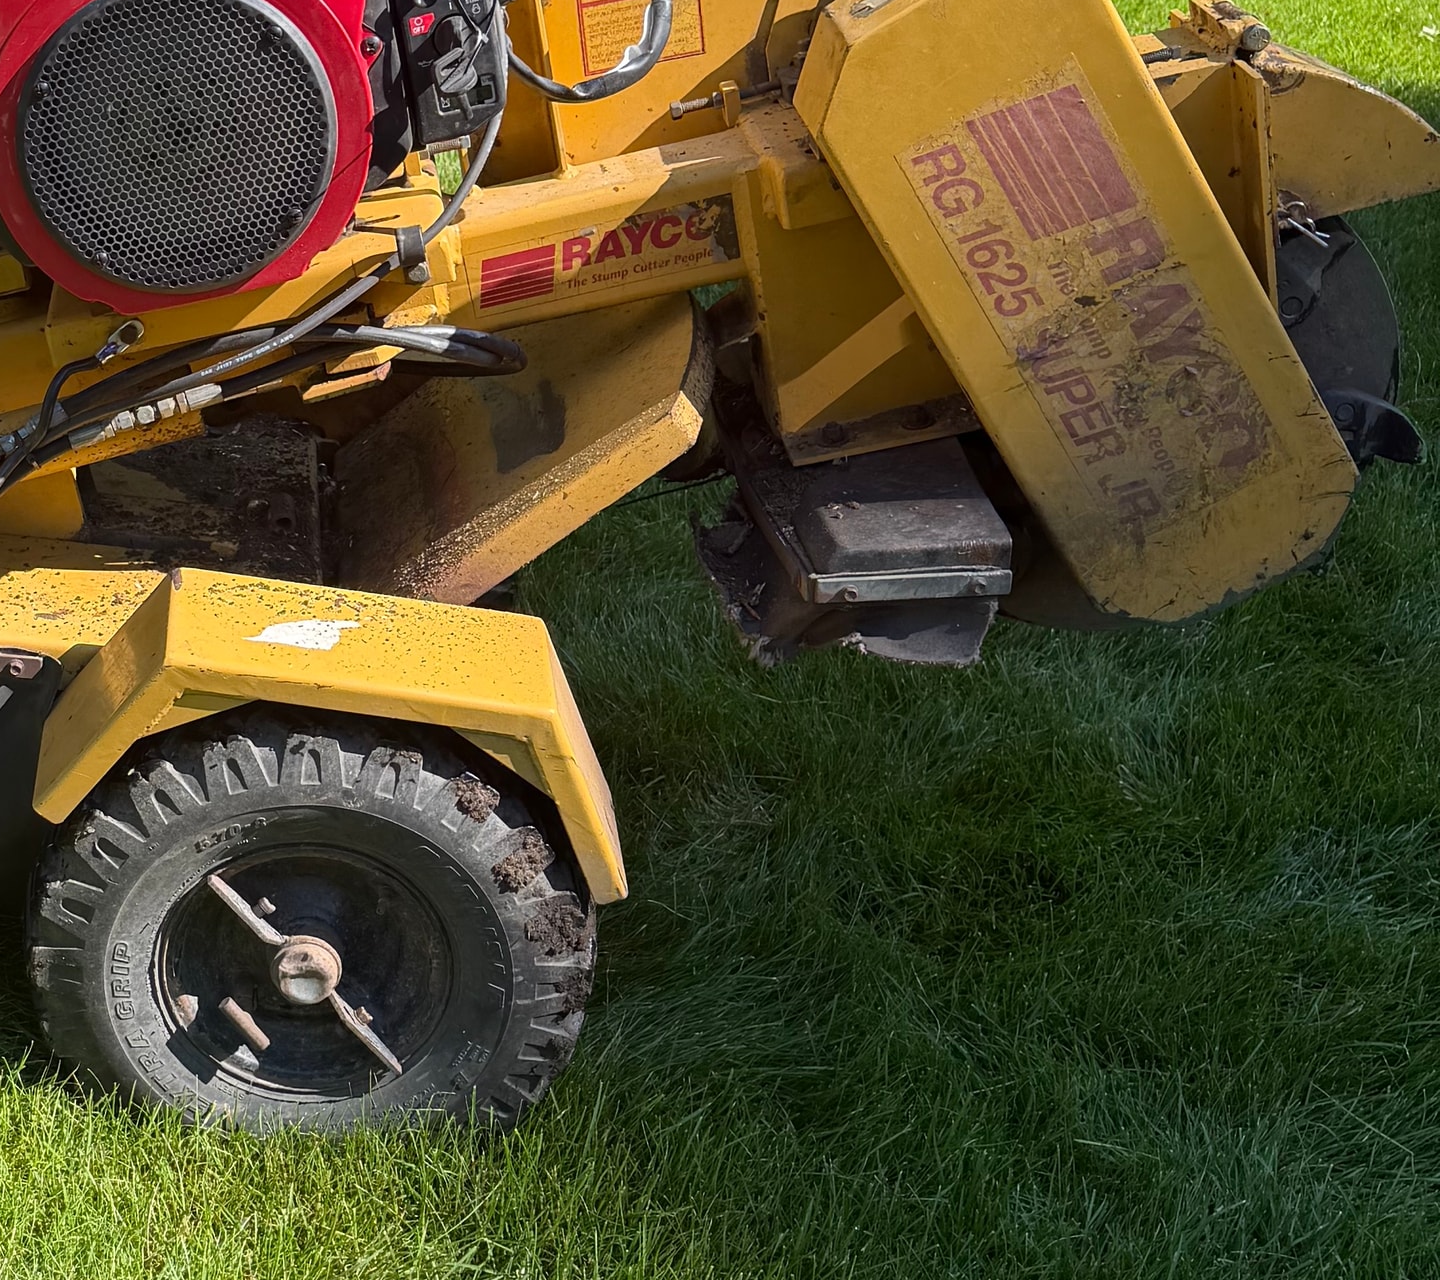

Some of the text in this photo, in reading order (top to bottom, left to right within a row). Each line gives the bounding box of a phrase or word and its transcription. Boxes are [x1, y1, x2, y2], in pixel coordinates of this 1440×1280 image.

[412, 24, 425, 34] OFF
[591, 268, 629, 284] Stump
[632, 258, 671, 275] Cutter
[673, 247, 714, 265] People
[910, 143, 985, 220] RG
[956, 218, 1046, 318] 1625
[1017, 325, 1127, 467] SUPER
[235, 352, 254, 363] TYPE
[280, 333, 294, 344] AWG
[111, 941, 136, 1021] GRIP
